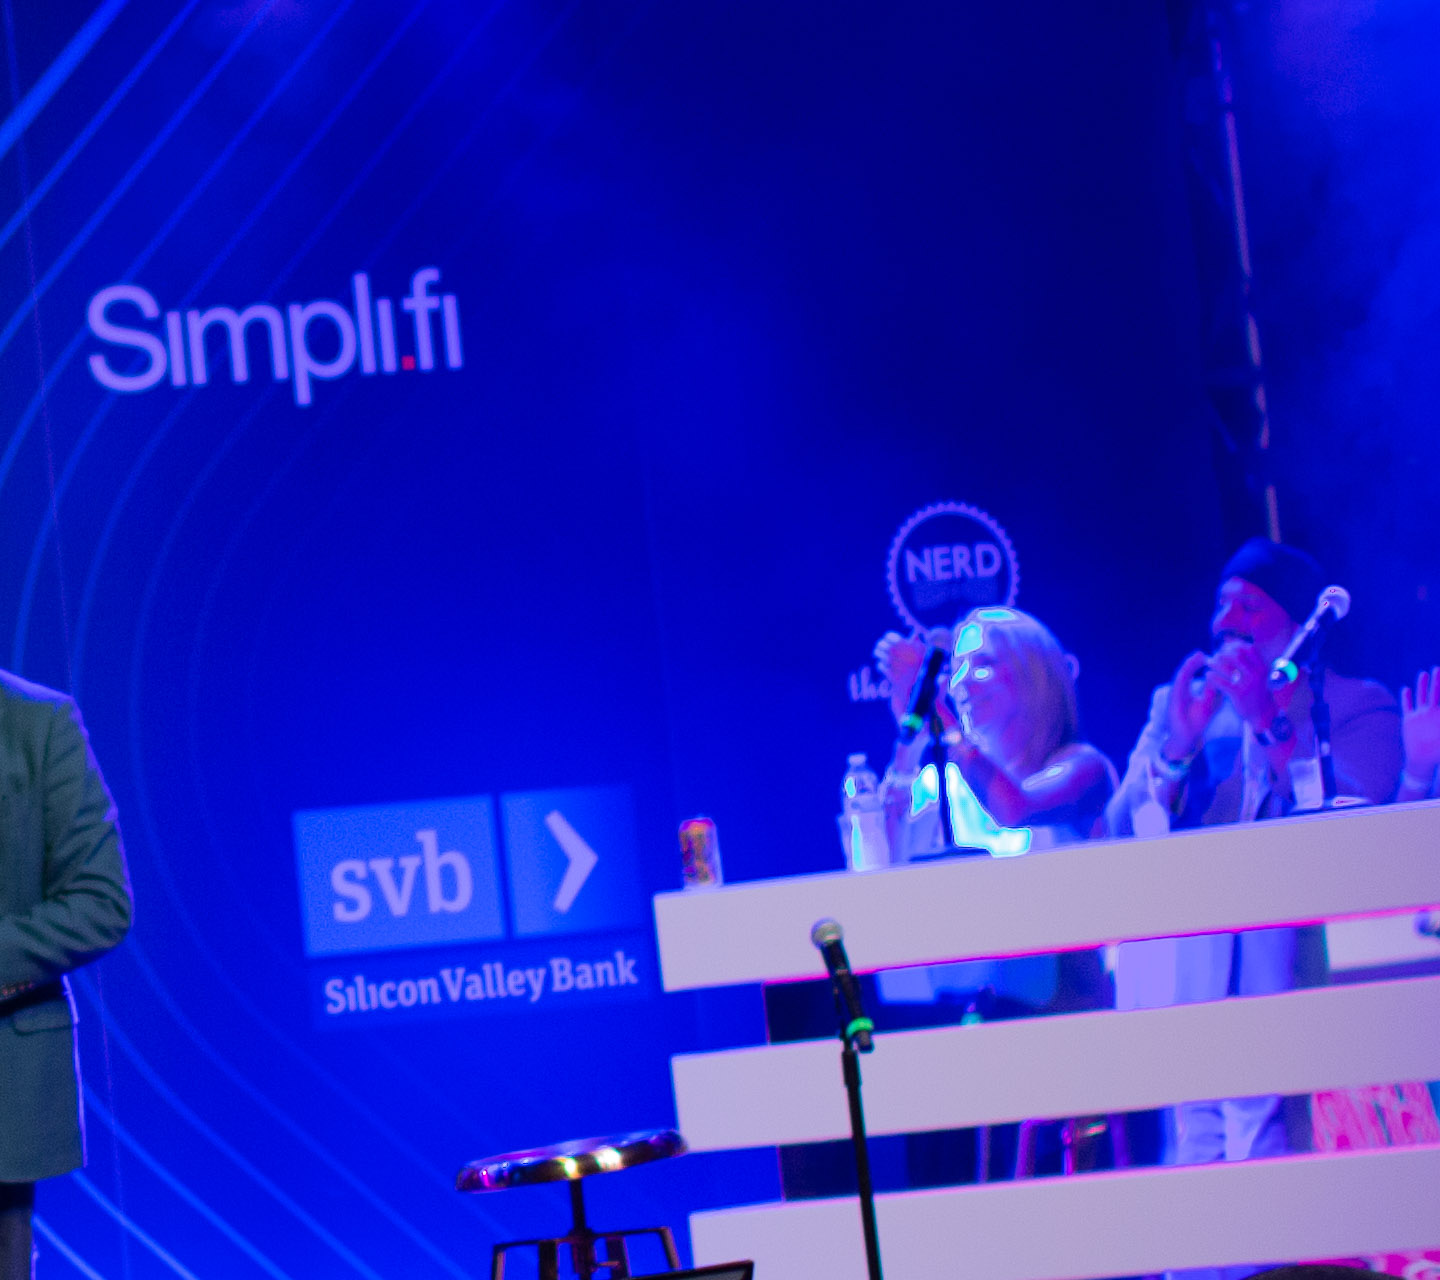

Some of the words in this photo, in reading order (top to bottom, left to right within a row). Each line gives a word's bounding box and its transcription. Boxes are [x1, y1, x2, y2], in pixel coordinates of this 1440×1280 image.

[86, 266, 464, 406] Simpli.fi
[905, 543, 1001, 583] NERD
[330, 829, 474, 922] svb
[325, 973, 440, 1015] Silicon
[440, 962, 546, 1003] Valley
[551, 951, 638, 993] Bank
